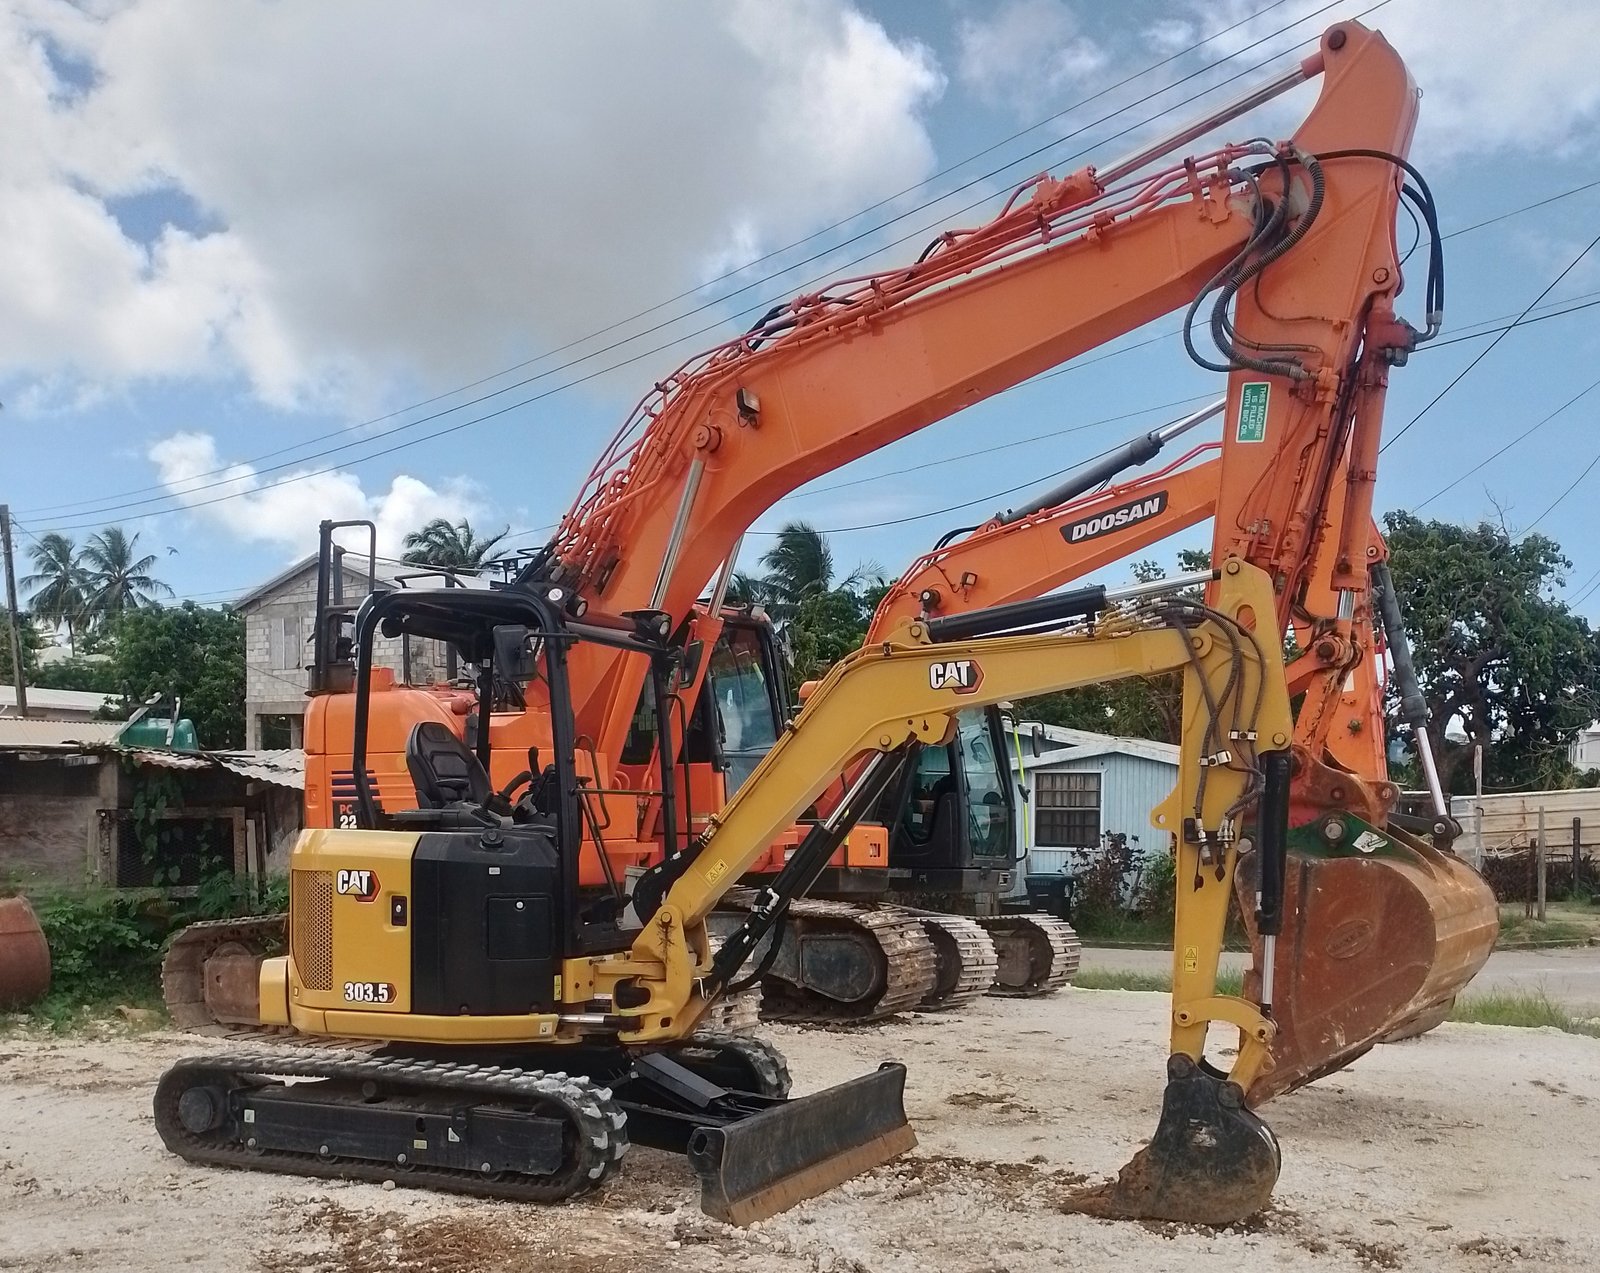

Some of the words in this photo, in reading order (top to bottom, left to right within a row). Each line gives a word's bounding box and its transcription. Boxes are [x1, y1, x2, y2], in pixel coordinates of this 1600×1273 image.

[1243, 388, 1252, 408] WITH
[1251, 395, 1258, 403] IS
[1258, 386, 1267, 404] THIS
[1242, 409, 1250, 423] BIO
[1248, 405, 1257, 430] FILLED
[1254, 405, 1265, 438] MACHINE
[1240, 424, 1248, 437] OIL
[1071, 496, 1160, 541] DOOSAN
[930, 661, 970, 689] CAT
[340, 804, 353, 815] PC
[337, 870, 370, 895] CAT
[344, 982, 389, 1003] 303.5
